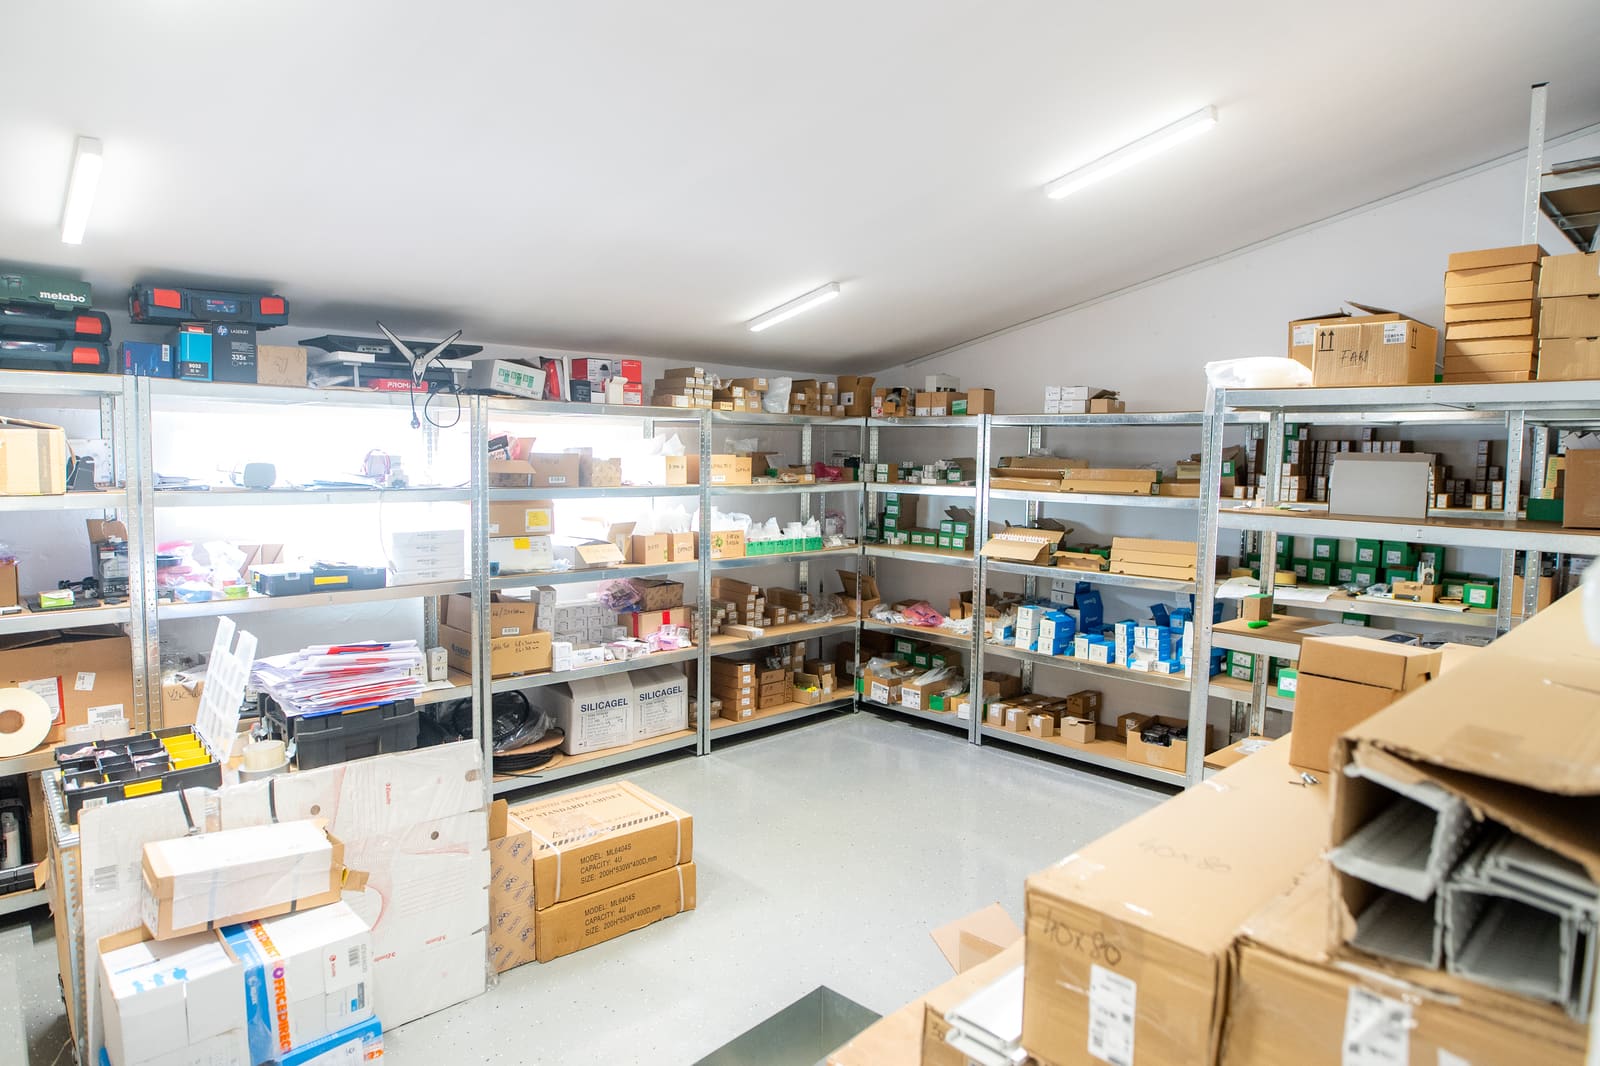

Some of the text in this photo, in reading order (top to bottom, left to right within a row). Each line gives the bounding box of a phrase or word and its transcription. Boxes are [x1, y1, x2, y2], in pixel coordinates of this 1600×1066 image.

[40, 291, 86, 303] metabo
[639, 685, 683, 701] SILICAGEL
[580, 698, 629, 713] SILICAGEL
[273, 967, 292, 1052] OFFICEDIREC
